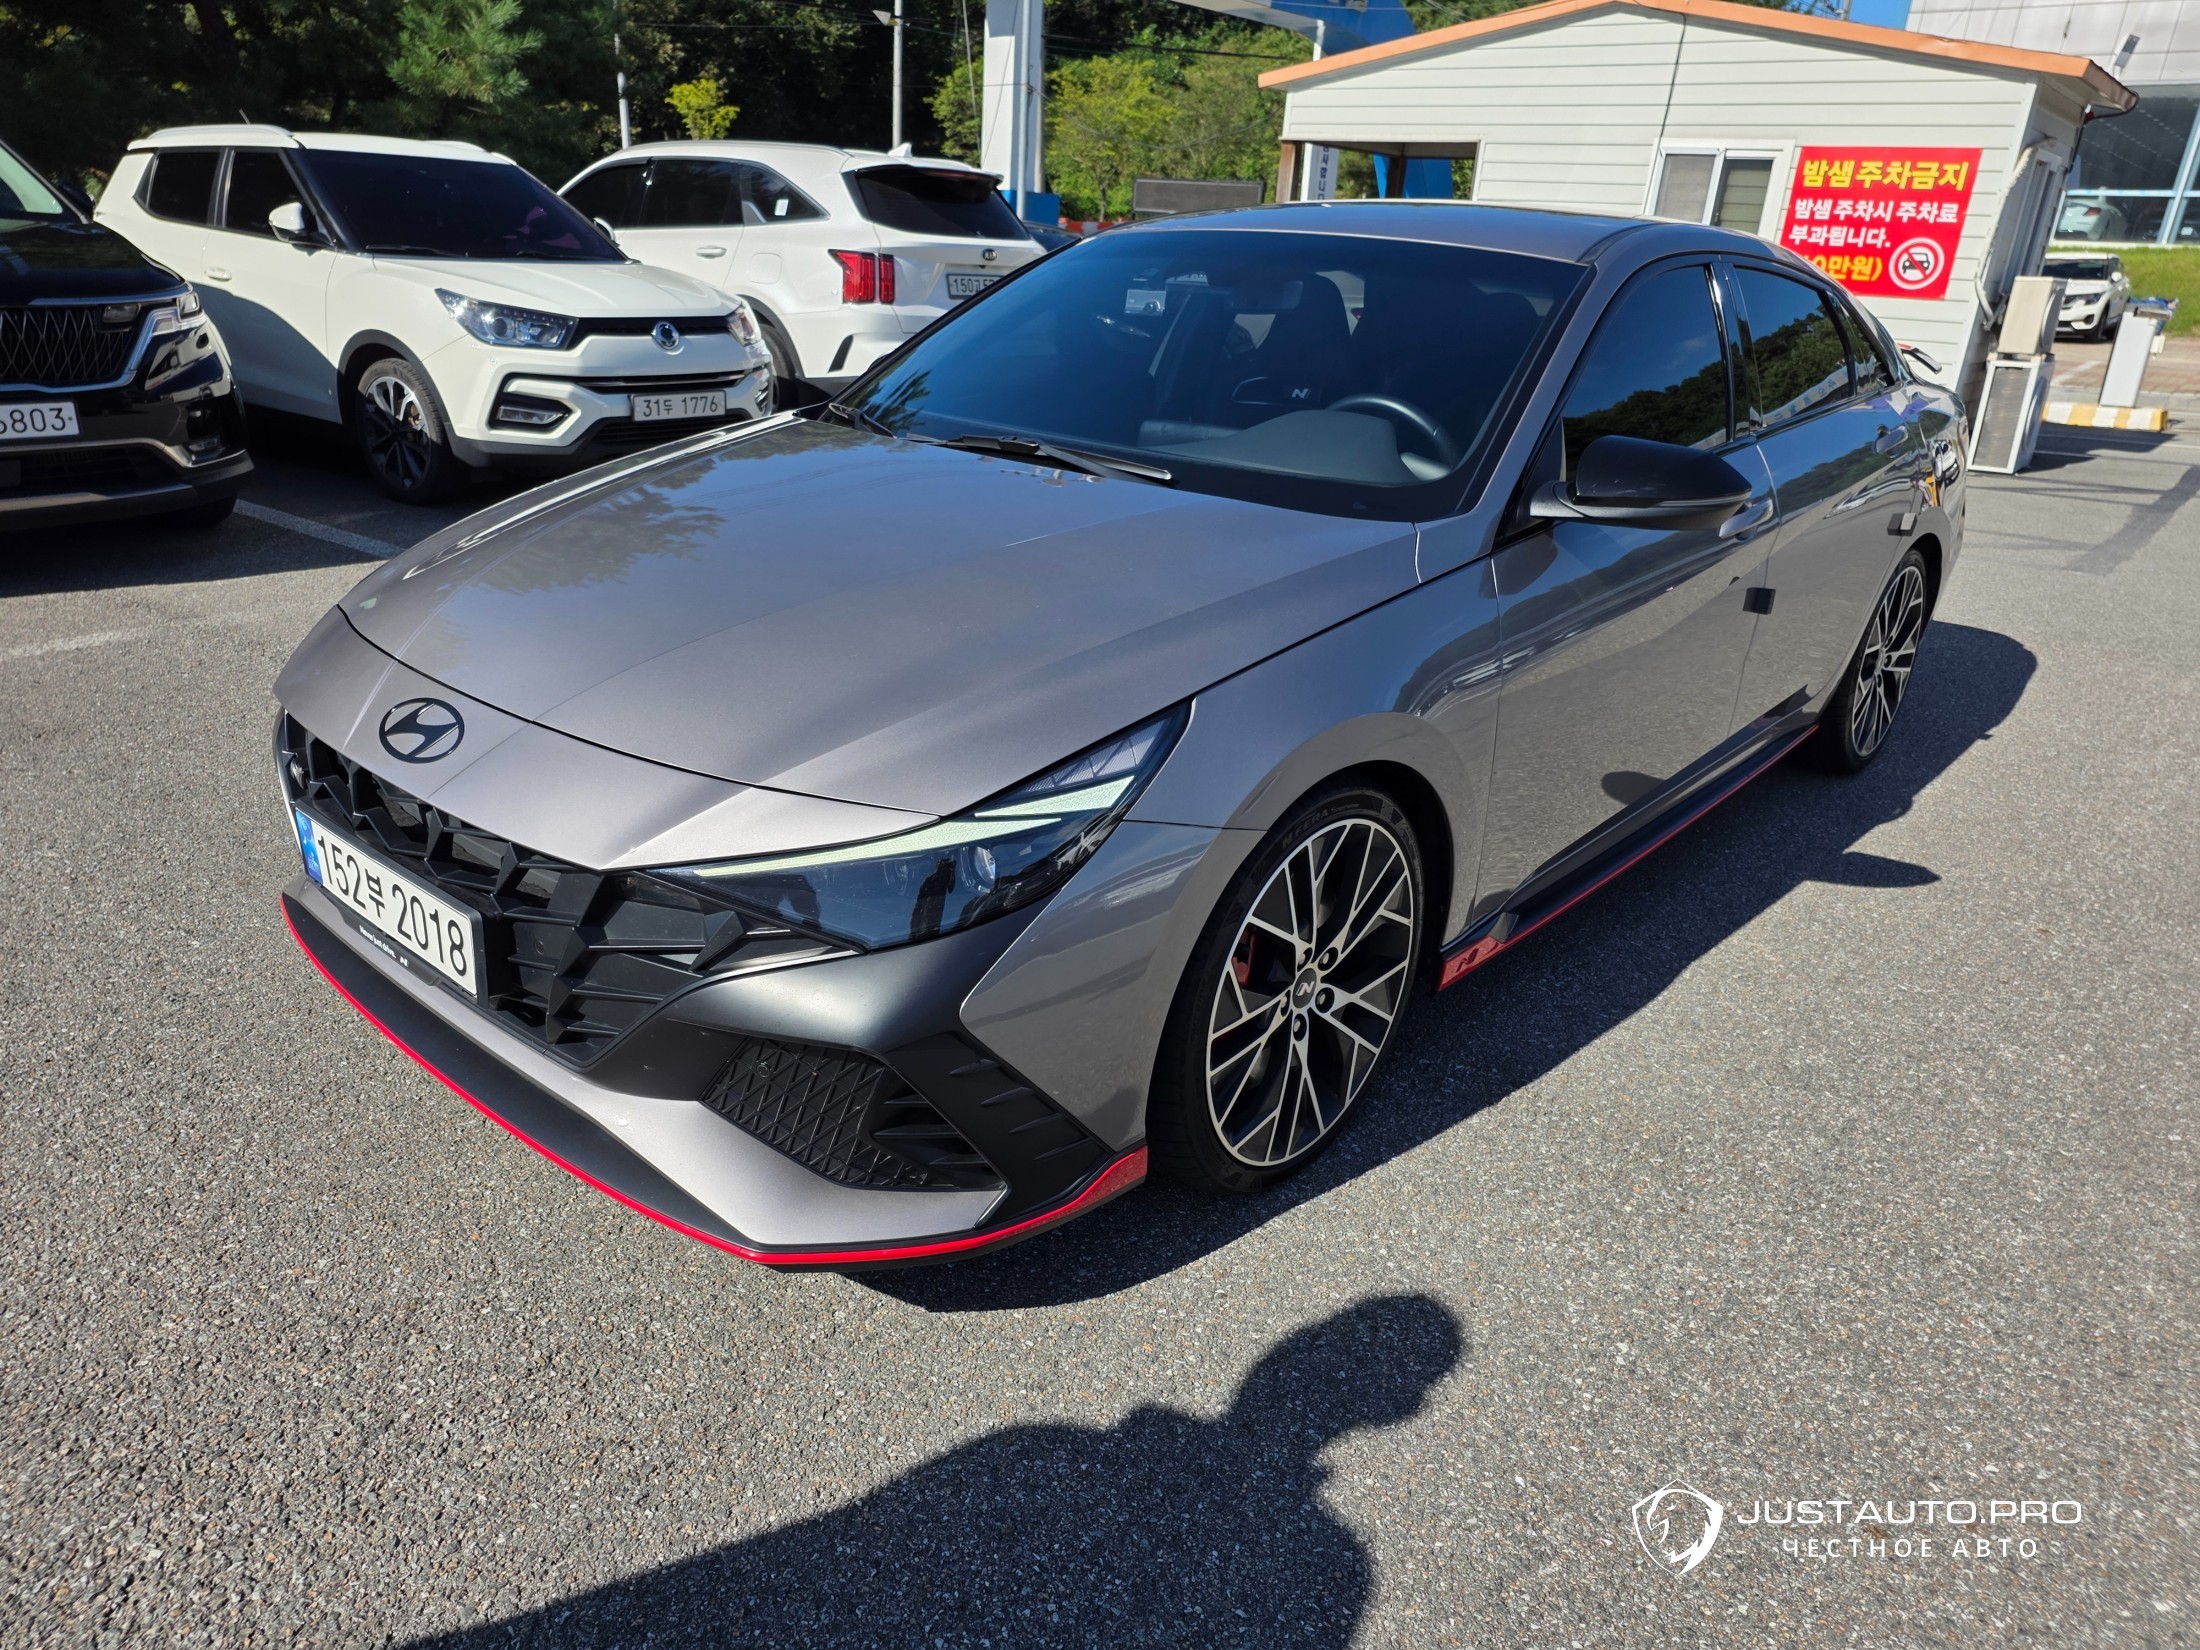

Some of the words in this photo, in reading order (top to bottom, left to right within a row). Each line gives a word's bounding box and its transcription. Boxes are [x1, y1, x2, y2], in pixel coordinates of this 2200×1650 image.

[1803, 160, 1855, 188] 밤샘
[1856, 161, 1969, 191] 주차금지
[1795, 198, 1833, 219] 밤샘
[1833, 200, 1894, 222] 주차시
[1896, 202, 1959, 223] 주차료
[1789, 225, 1891, 248] 부과됩니다.
[643, 398, 673, 417] 31두
[681, 395, 718, 414] 1776
[318, 835, 385, 919] 152부
[391, 884, 467, 977] 2018
